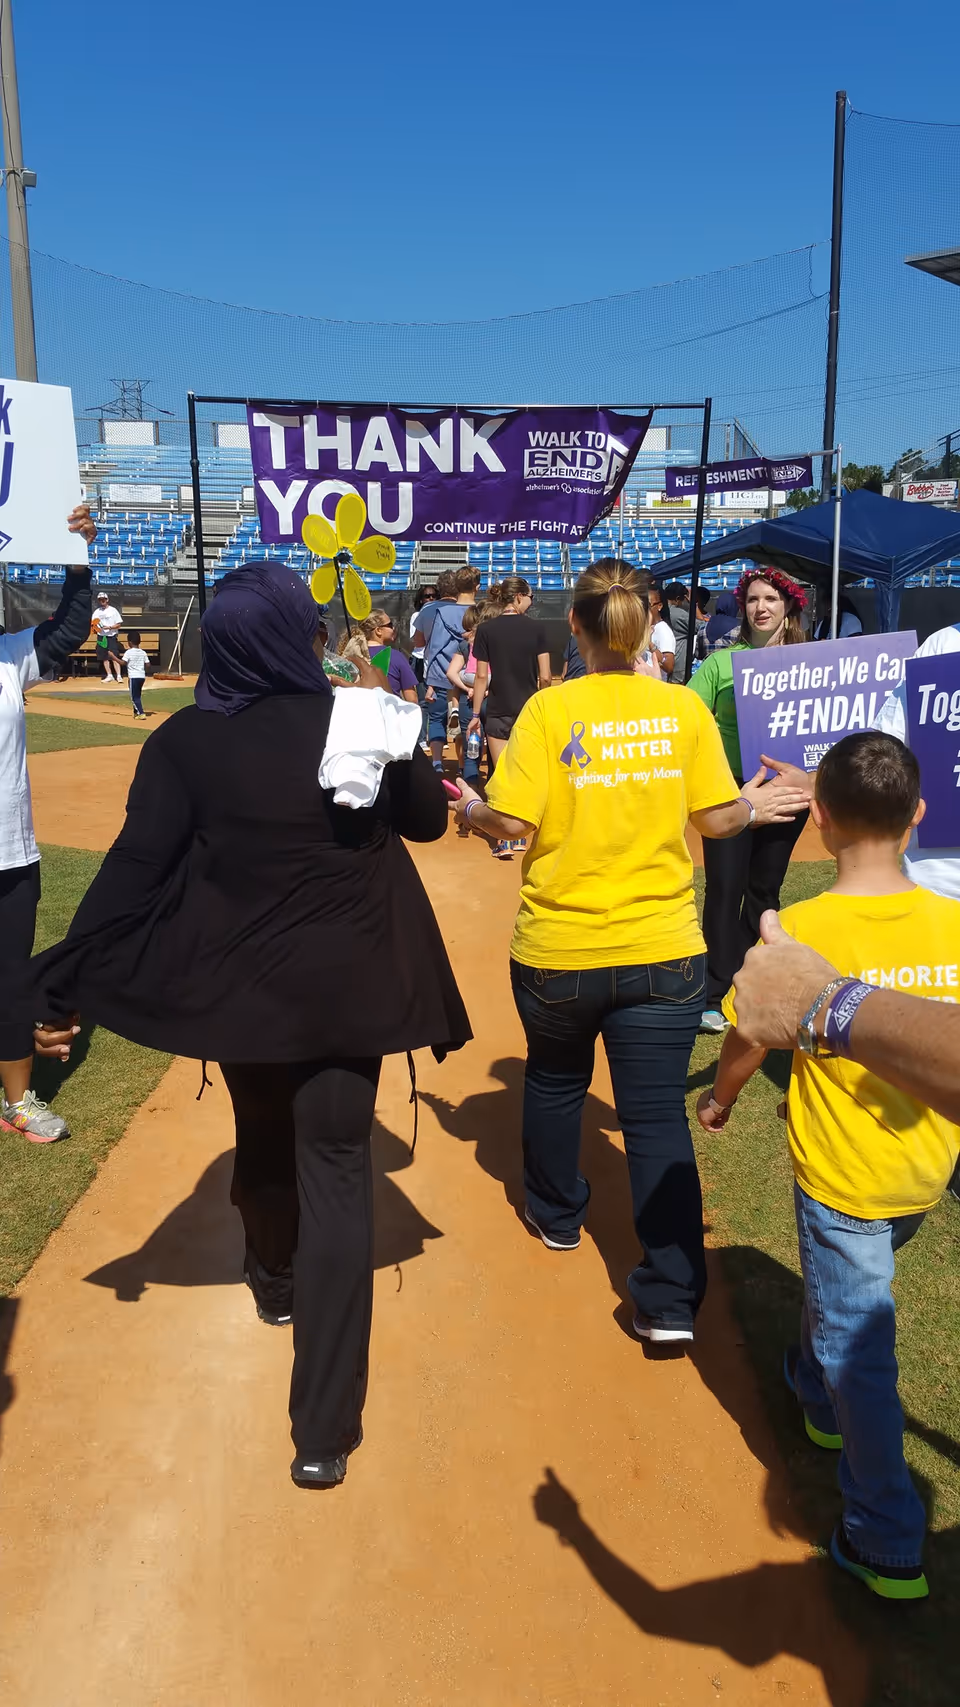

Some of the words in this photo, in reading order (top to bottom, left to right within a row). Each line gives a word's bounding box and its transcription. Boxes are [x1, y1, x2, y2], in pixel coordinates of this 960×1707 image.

[253, 412, 506, 473] THANK
[528, 431, 582, 447] WALK
[584, 431, 606, 449] TO
[528, 450, 604, 470] END
[526, 468, 602, 481] ALZHEIMER'S
[675, 466, 769, 488] REFESHMENT
[258, 479, 413, 535] YOU
[424, 522, 497, 535] CONTINUE
[500, 520, 526, 534] THE
[530, 520, 569, 534] FIGHT
[569, 525, 586, 536] AT
[838, 656, 869, 685] We
[768, 690, 893, 738] #ENDAL
[591, 717, 679, 738] MEMORIES
[602, 739, 672, 761] MATTER
[804, 742, 830, 752] WALK
[568, 769, 612, 789] Fighting
[612, 768, 629, 787] for
[633, 771, 651, 785] my
[653, 766, 682, 779] Mom
